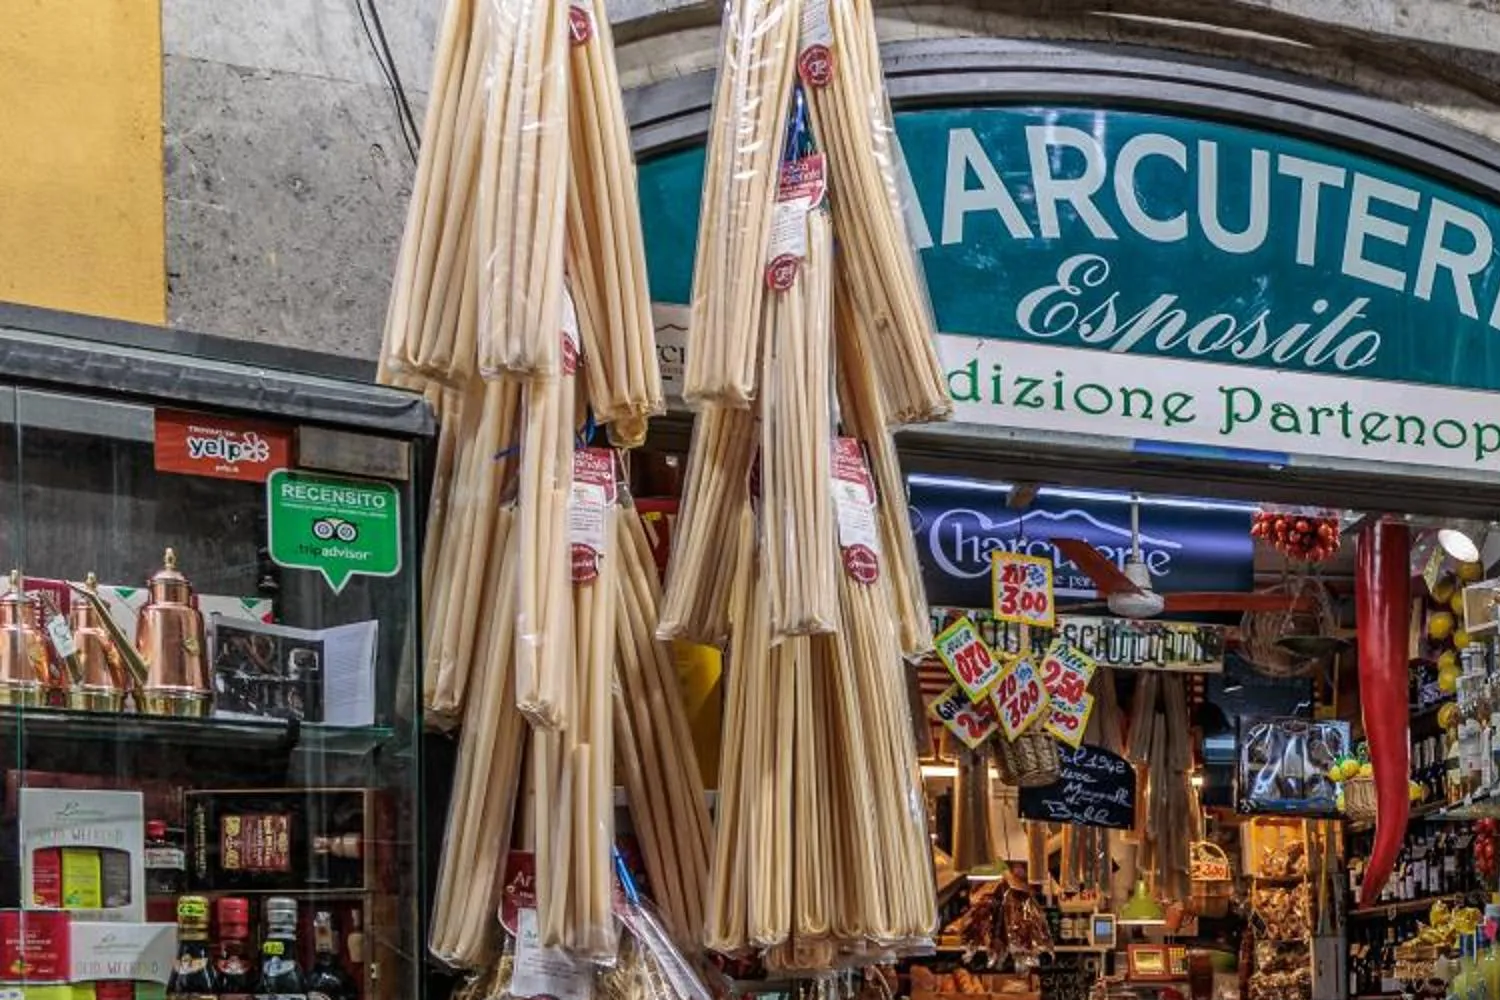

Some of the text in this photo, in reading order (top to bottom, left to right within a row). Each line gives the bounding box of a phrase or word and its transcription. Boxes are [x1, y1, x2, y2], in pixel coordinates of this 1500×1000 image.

[1016, 253, 1381, 370] Esposito
[947, 359, 1196, 421] dizione
[189, 437, 242, 461] yelp
[281, 484, 386, 508] RECENSITO
[299, 543, 369, 561] tripadvisor
[929, 508, 1172, 579] Charcuerie
